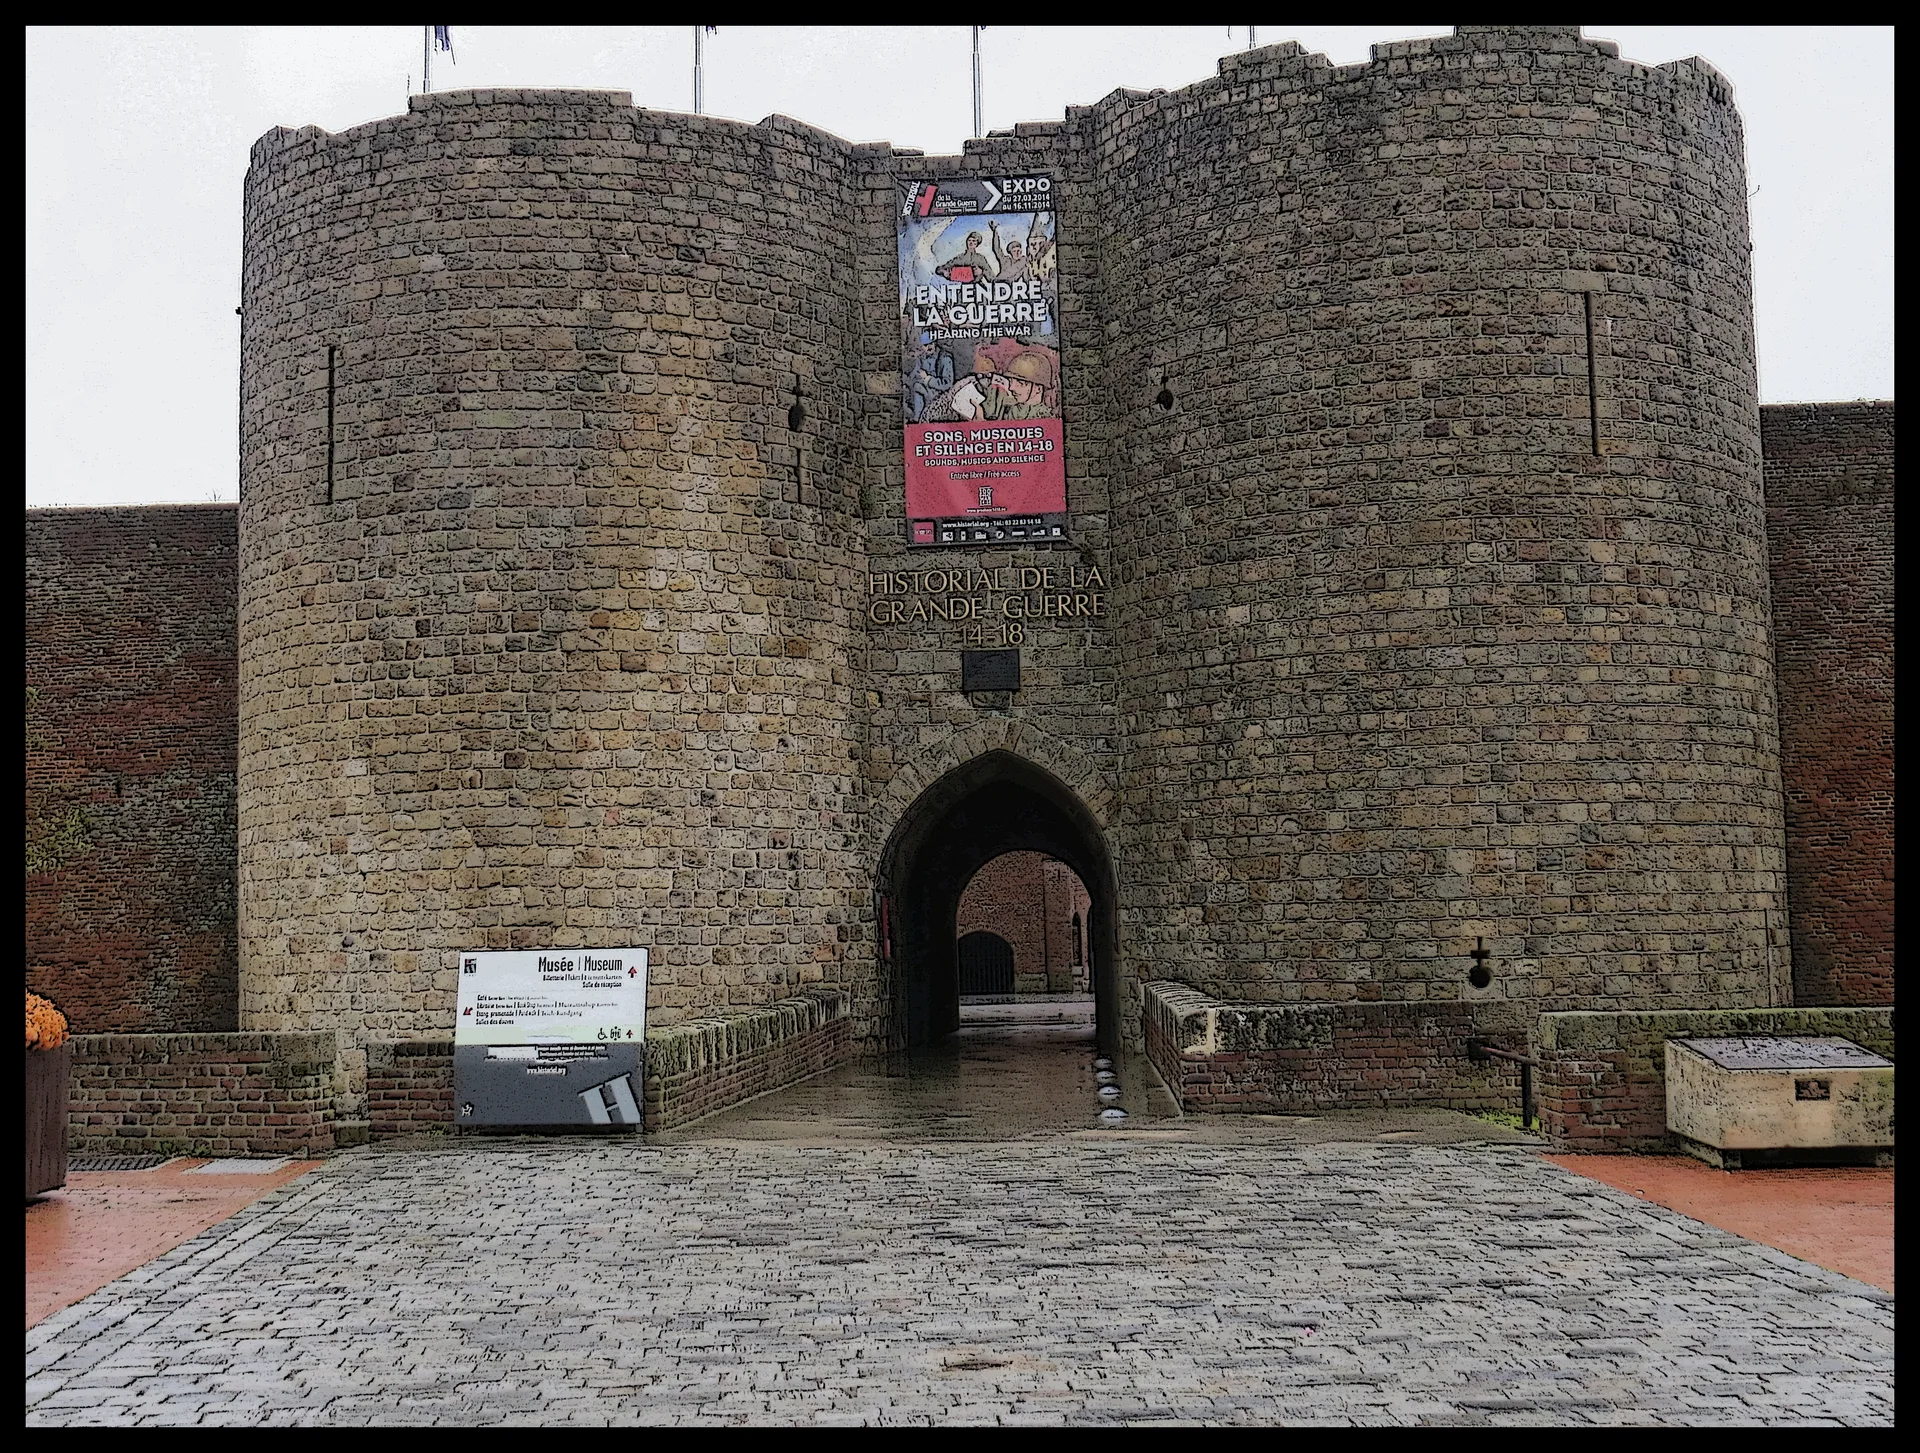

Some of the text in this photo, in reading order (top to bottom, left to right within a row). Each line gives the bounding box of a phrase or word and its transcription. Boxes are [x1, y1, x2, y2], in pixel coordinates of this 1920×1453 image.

[1003, 178, 1051, 193] EXPO
[1012, 194, 1050, 202] 27.03.2014
[1013, 202, 1050, 210] 16.11.2014
[916, 280, 1041, 304] ENTENDRE
[913, 302, 1047, 327] LA GUERRE
[930, 326, 1031, 340] HEARING THE WAR
[924, 427, 1043, 443] SONS, MUSIQUES
[915, 440, 1053, 456] ET SILENCE EN 14-18
[924, 454, 1044, 467] SOUNDS, MUSICS AND SILENCE
[950, 472, 969, 480] Entrée
[970, 471, 983, 479] libre
[988, 470, 1000, 478] Free
[869, 565, 1105, 595] HISTORIAL DE LA
[870, 594, 1106, 624] GRANDE GUERRE
[962, 622, 1024, 645] 14-18
[538, 955, 623, 972] Musée Museum
